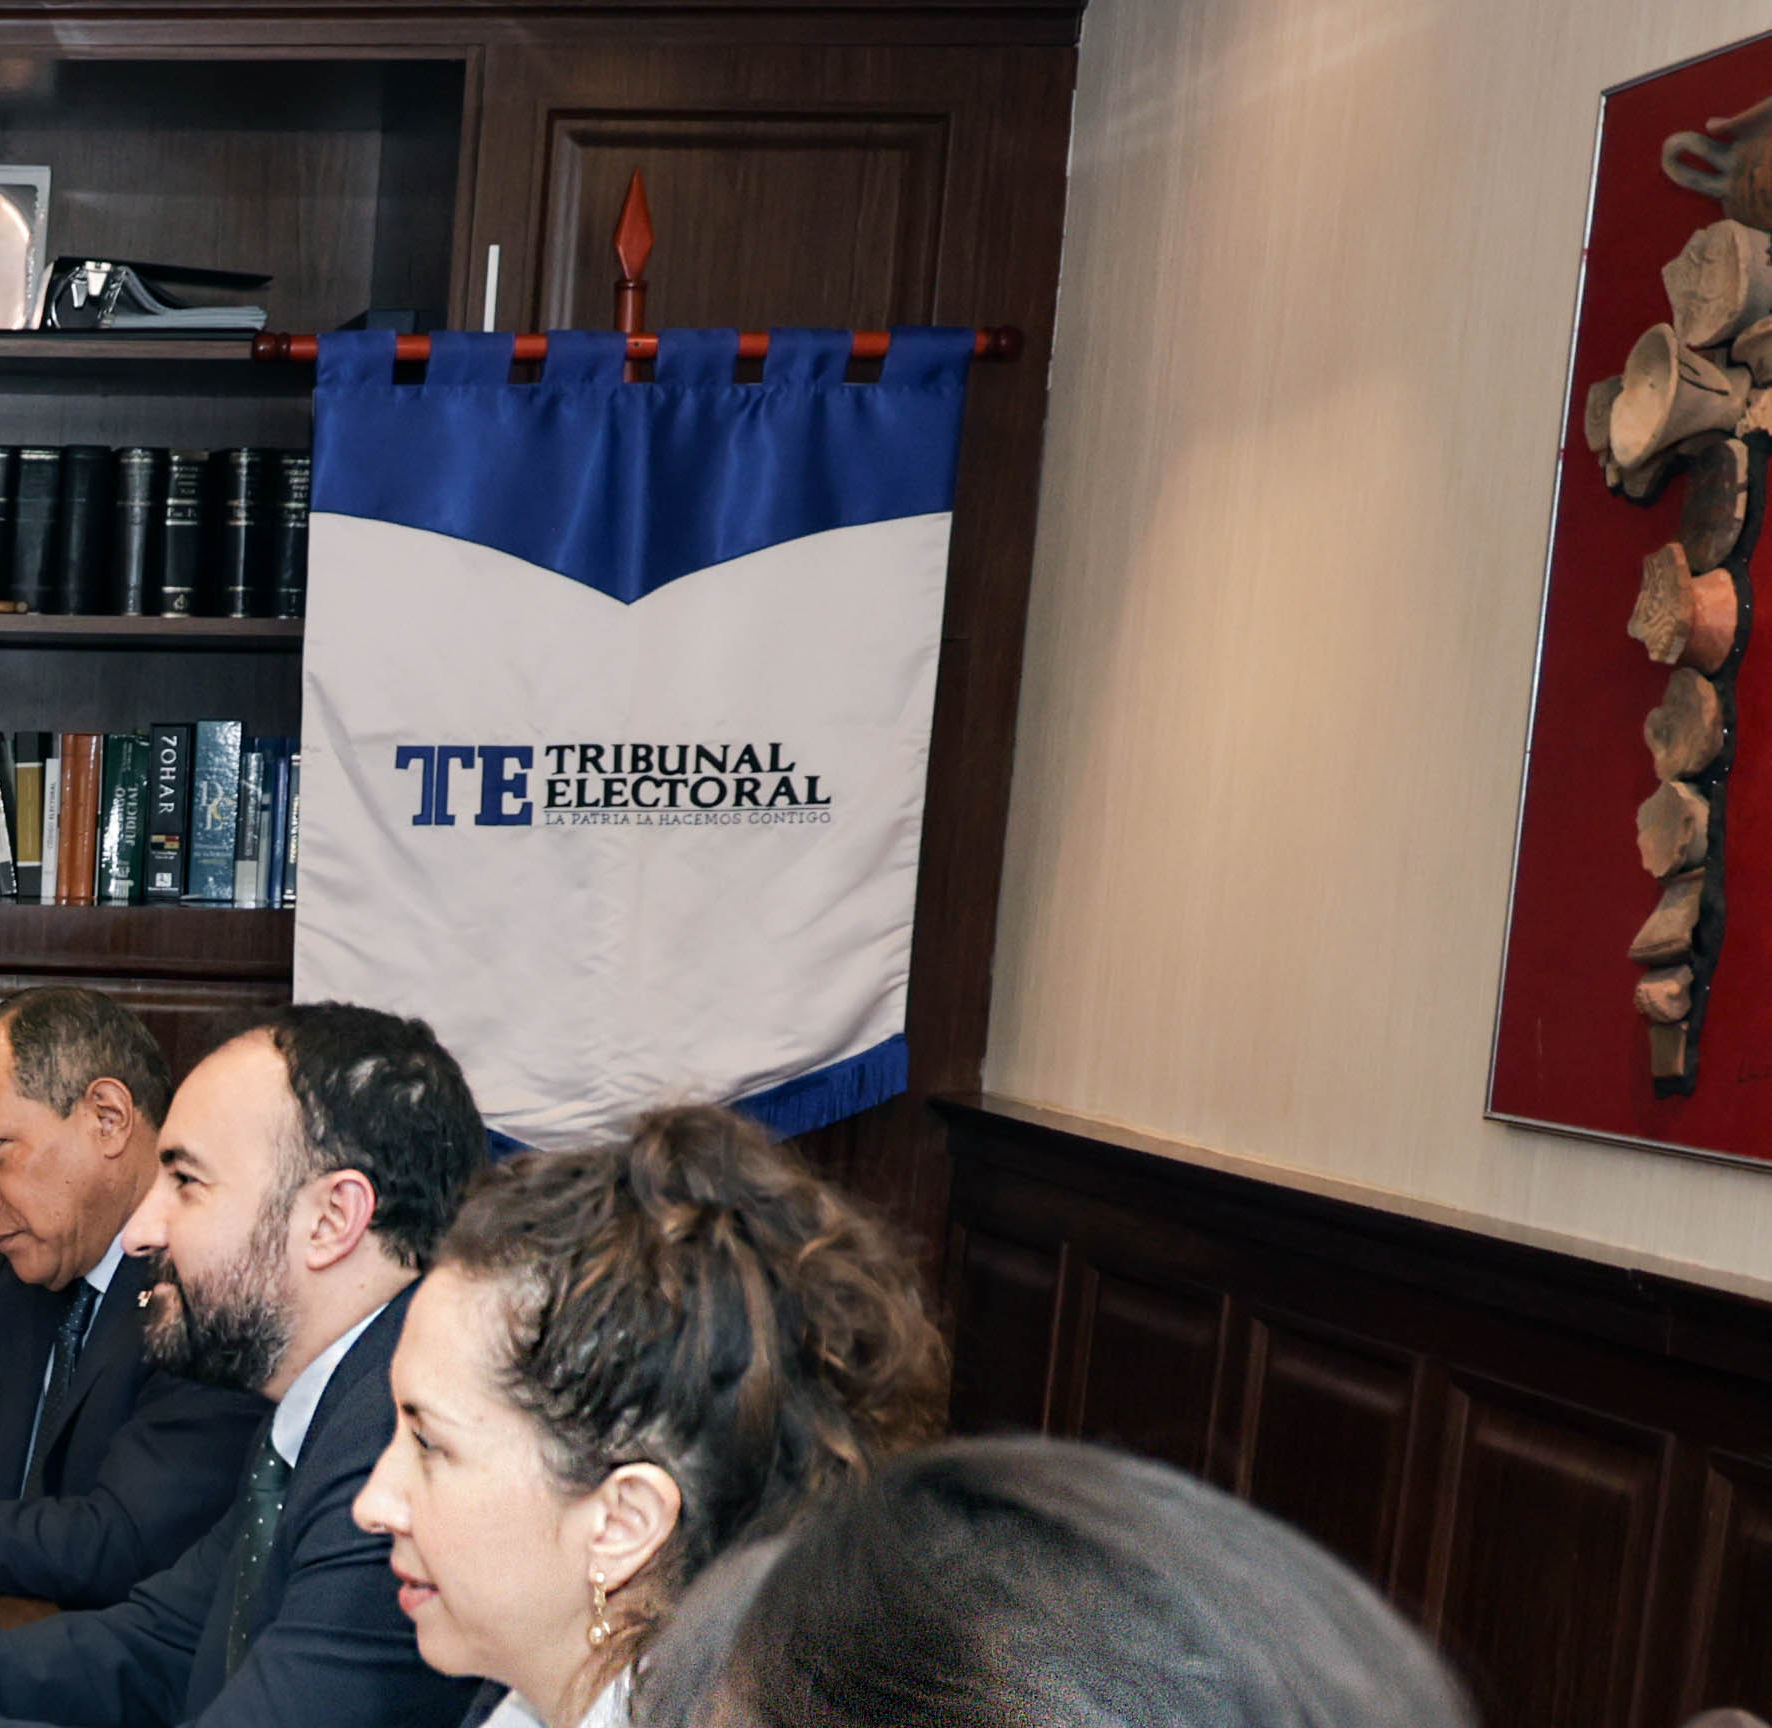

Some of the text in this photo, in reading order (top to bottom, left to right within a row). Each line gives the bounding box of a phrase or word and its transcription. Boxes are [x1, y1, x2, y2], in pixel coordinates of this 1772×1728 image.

[545, 743, 796, 776] TRIBUNAL
[396, 745, 534, 826] TE
[544, 775, 832, 809] ELECTORAL
[125, 783, 140, 847] JUDICIAL
[545, 811, 832, 826] LA PATRIA LA HACEMOS CONTIGO
